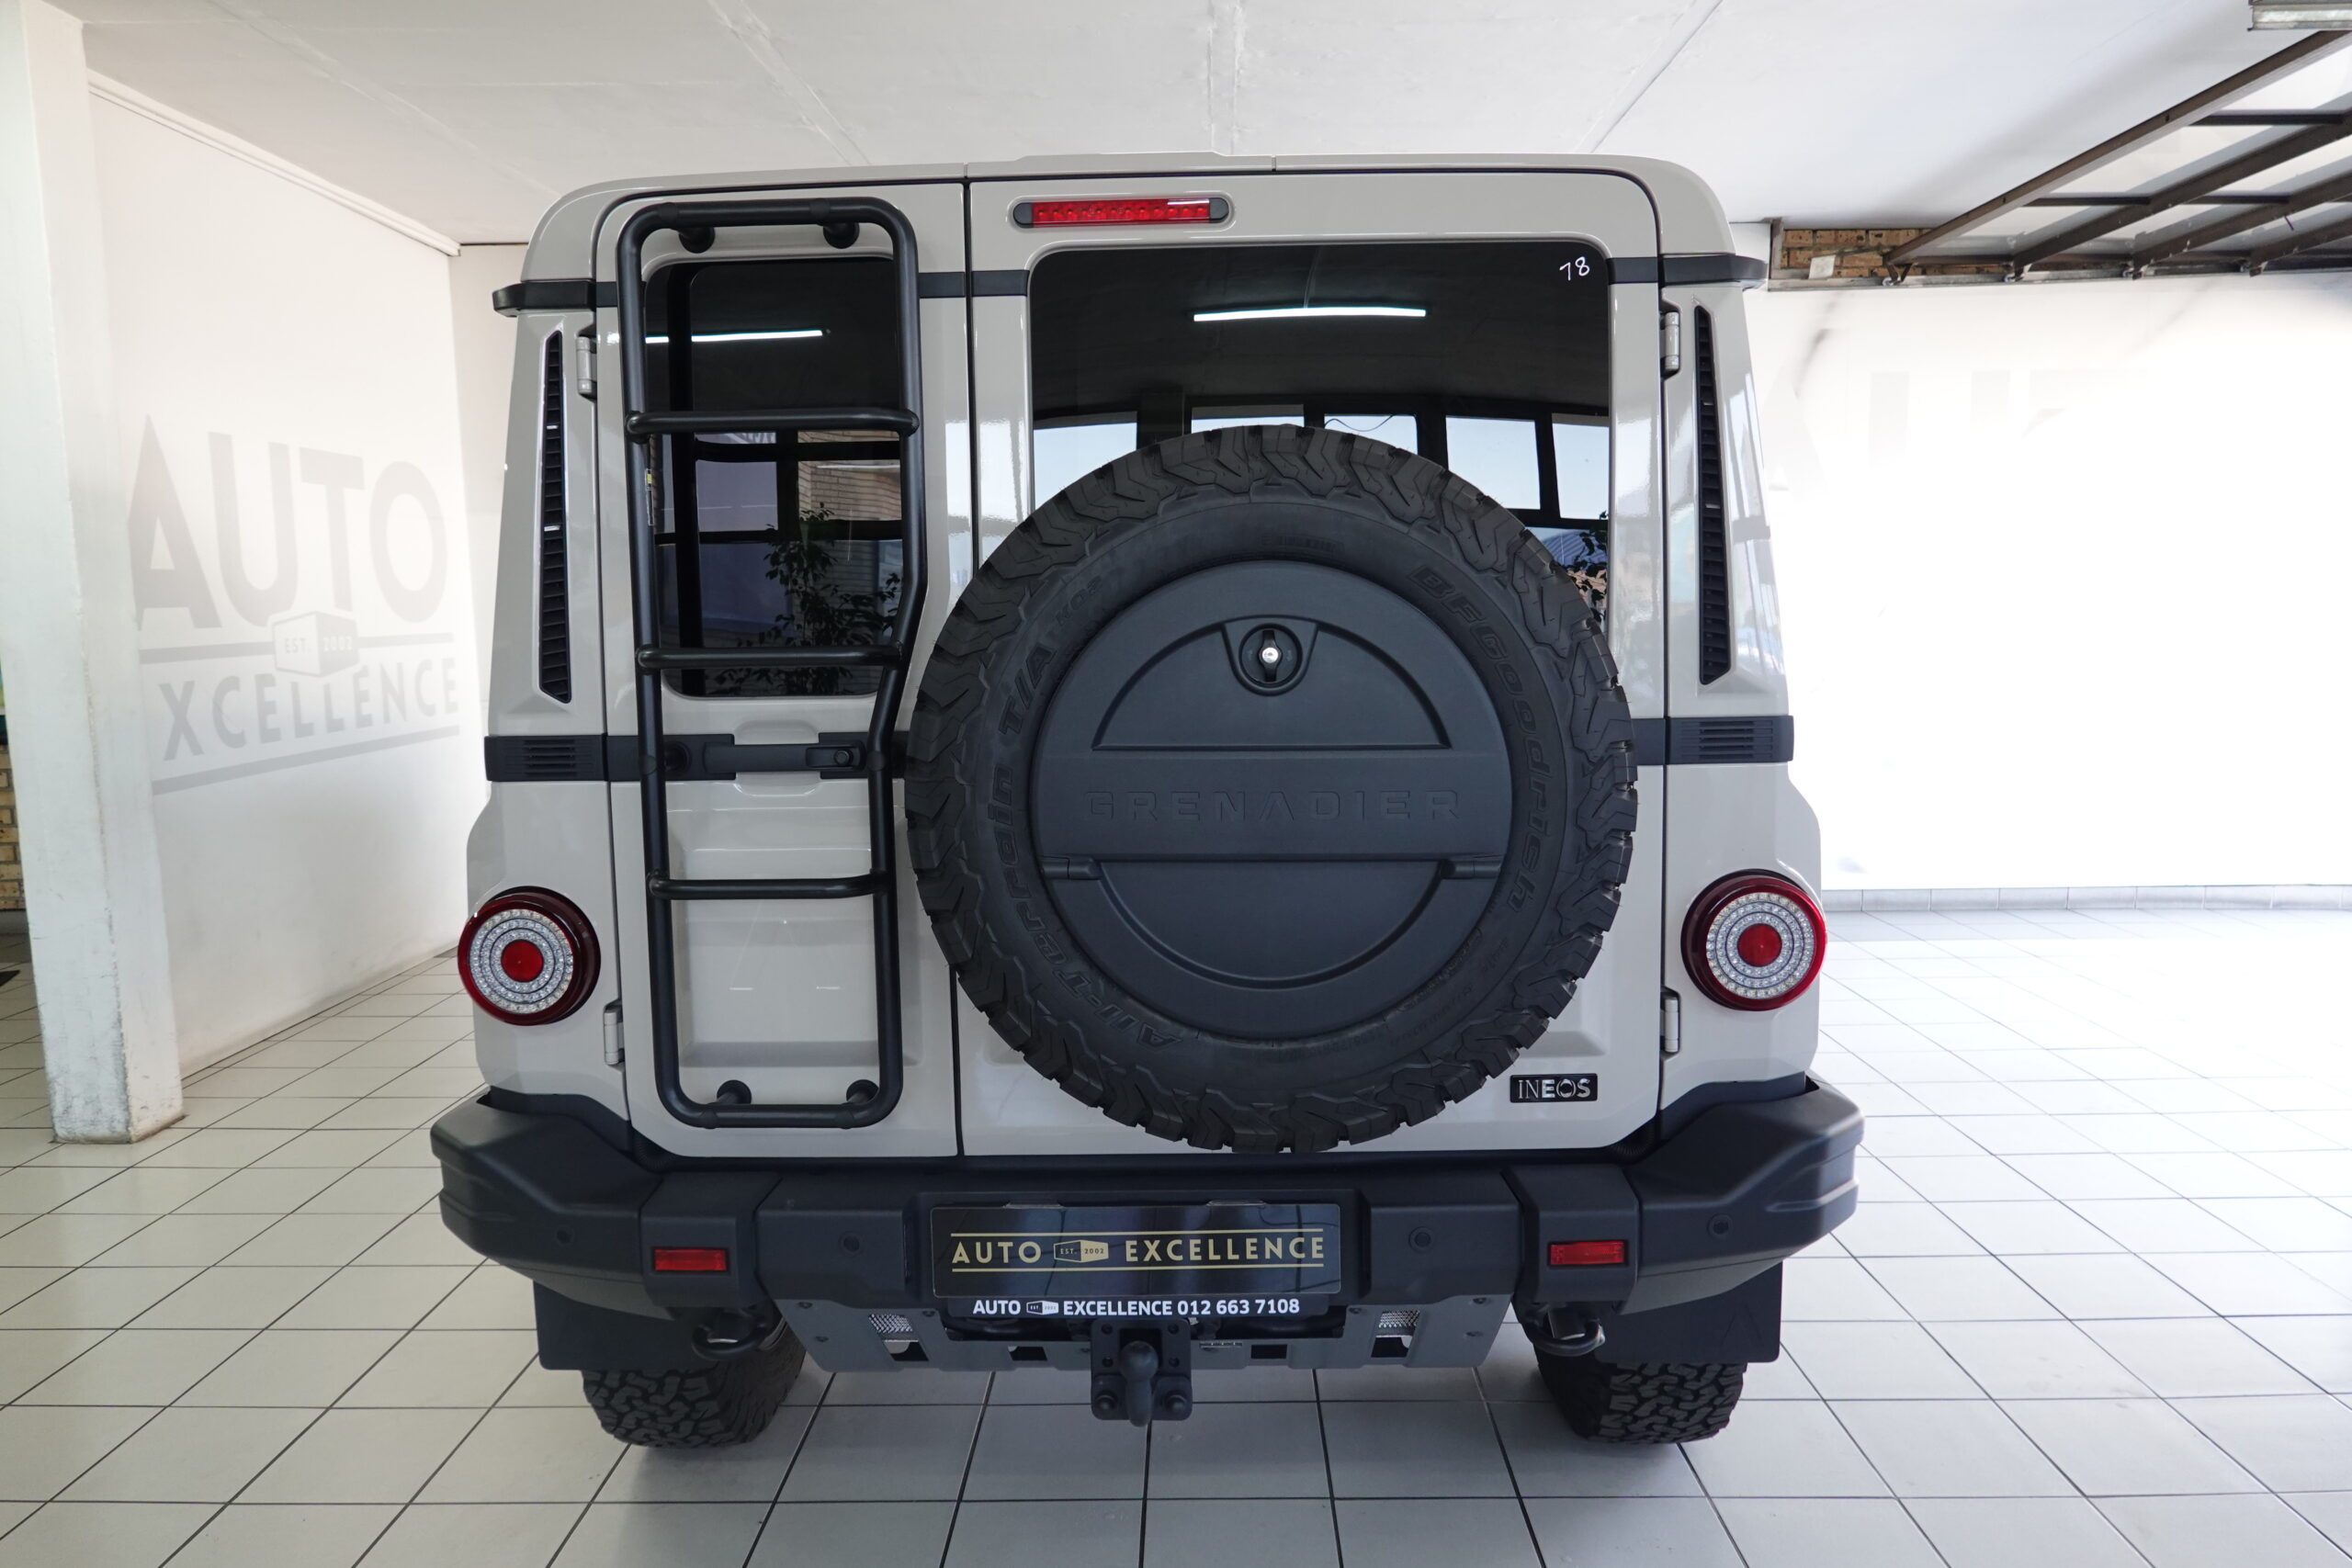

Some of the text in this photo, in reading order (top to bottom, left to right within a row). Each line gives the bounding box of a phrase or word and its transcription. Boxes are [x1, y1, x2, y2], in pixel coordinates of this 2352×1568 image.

[127, 413, 448, 632] AUTO
[158, 657, 459, 761] XCELLENCE
[998, 641, 1057, 736] T/A
[1408, 564, 1555, 913] BFGoodrich
[1084, 788, 1462, 822] GRENADIER
[1518, 1077, 1591, 1100] INEOS
[952, 1241, 1042, 1264] AUTO
[1125, 1236, 1325, 1262] EXCELLENCE
[972, 1299, 1022, 1315] AUTO
[1063, 1299, 1172, 1316] EXCELLENCE
[1177, 1300, 1211, 1315] 012
[1216, 1300, 1250, 1315] 663
[1255, 1298, 1300, 1314] 7108
